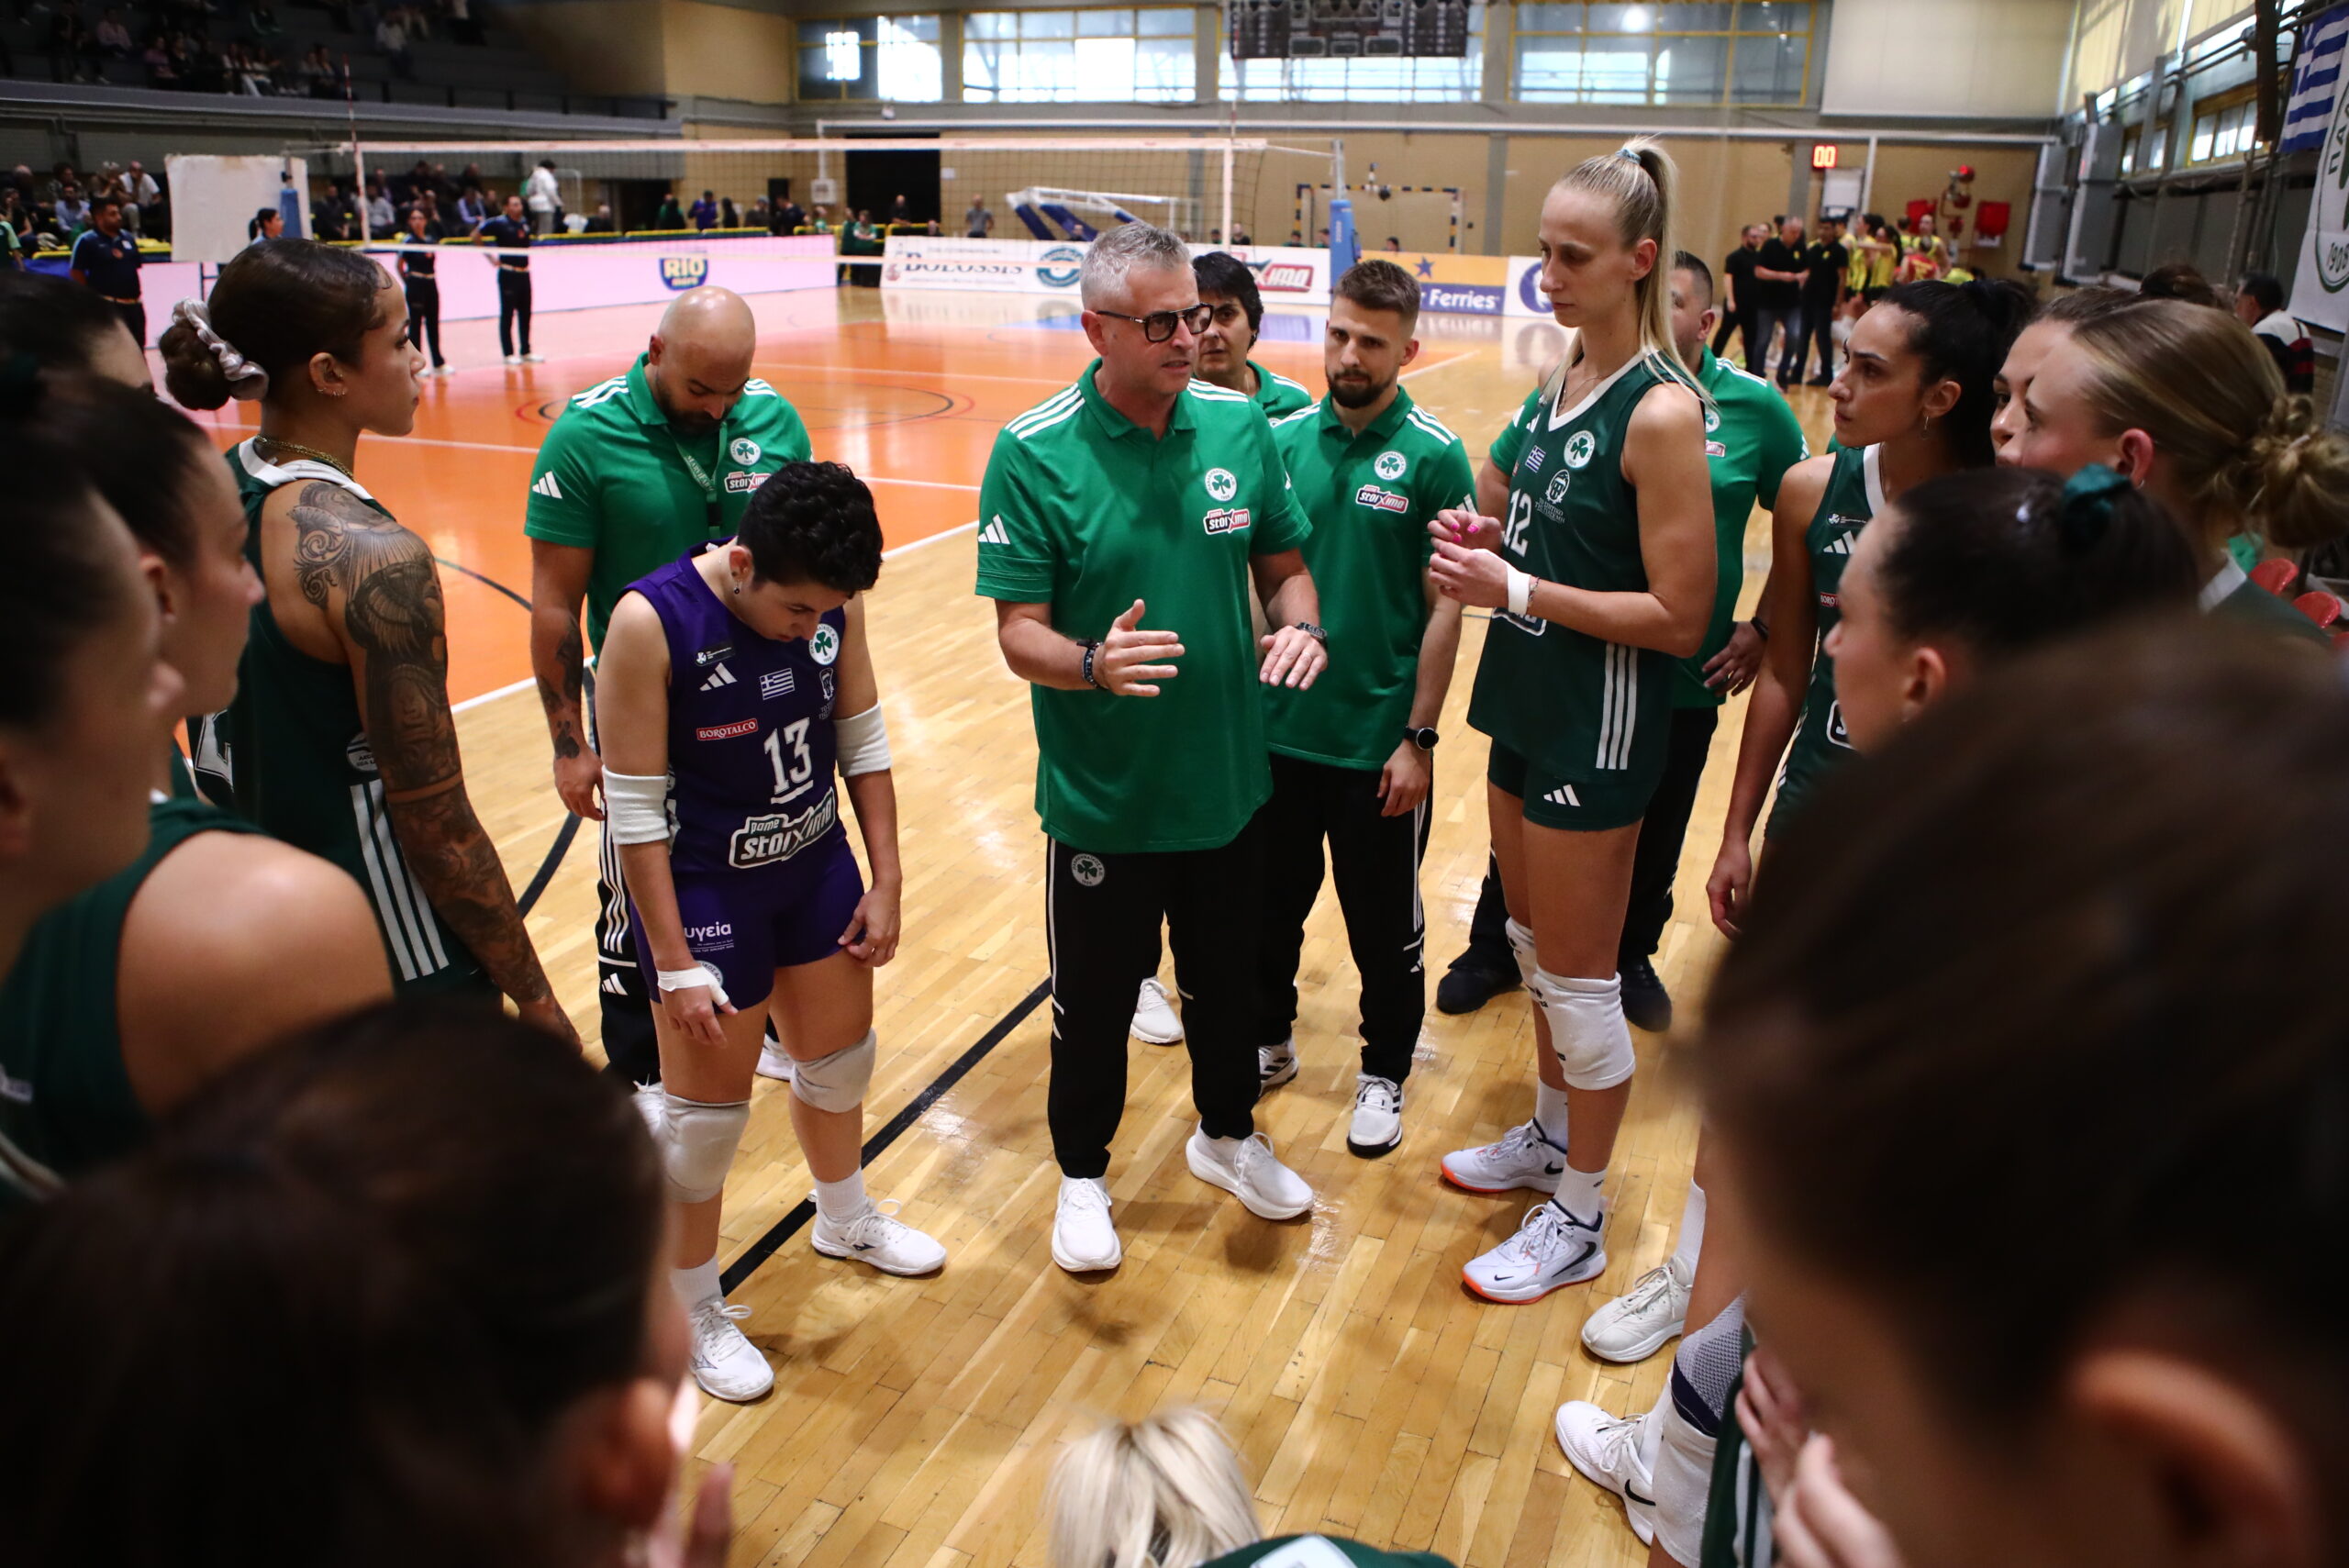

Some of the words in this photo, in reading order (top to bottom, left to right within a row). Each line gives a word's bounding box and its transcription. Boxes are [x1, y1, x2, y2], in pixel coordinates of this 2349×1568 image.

[1813, 145, 1836, 168] 00
[663, 258, 705, 278] RIO
[1430, 289, 1496, 308] Ferries
[1502, 488, 1531, 558] 12
[699, 721, 756, 739] BOROTALCO
[764, 717, 812, 795] 13
[751, 819, 780, 834] pame
